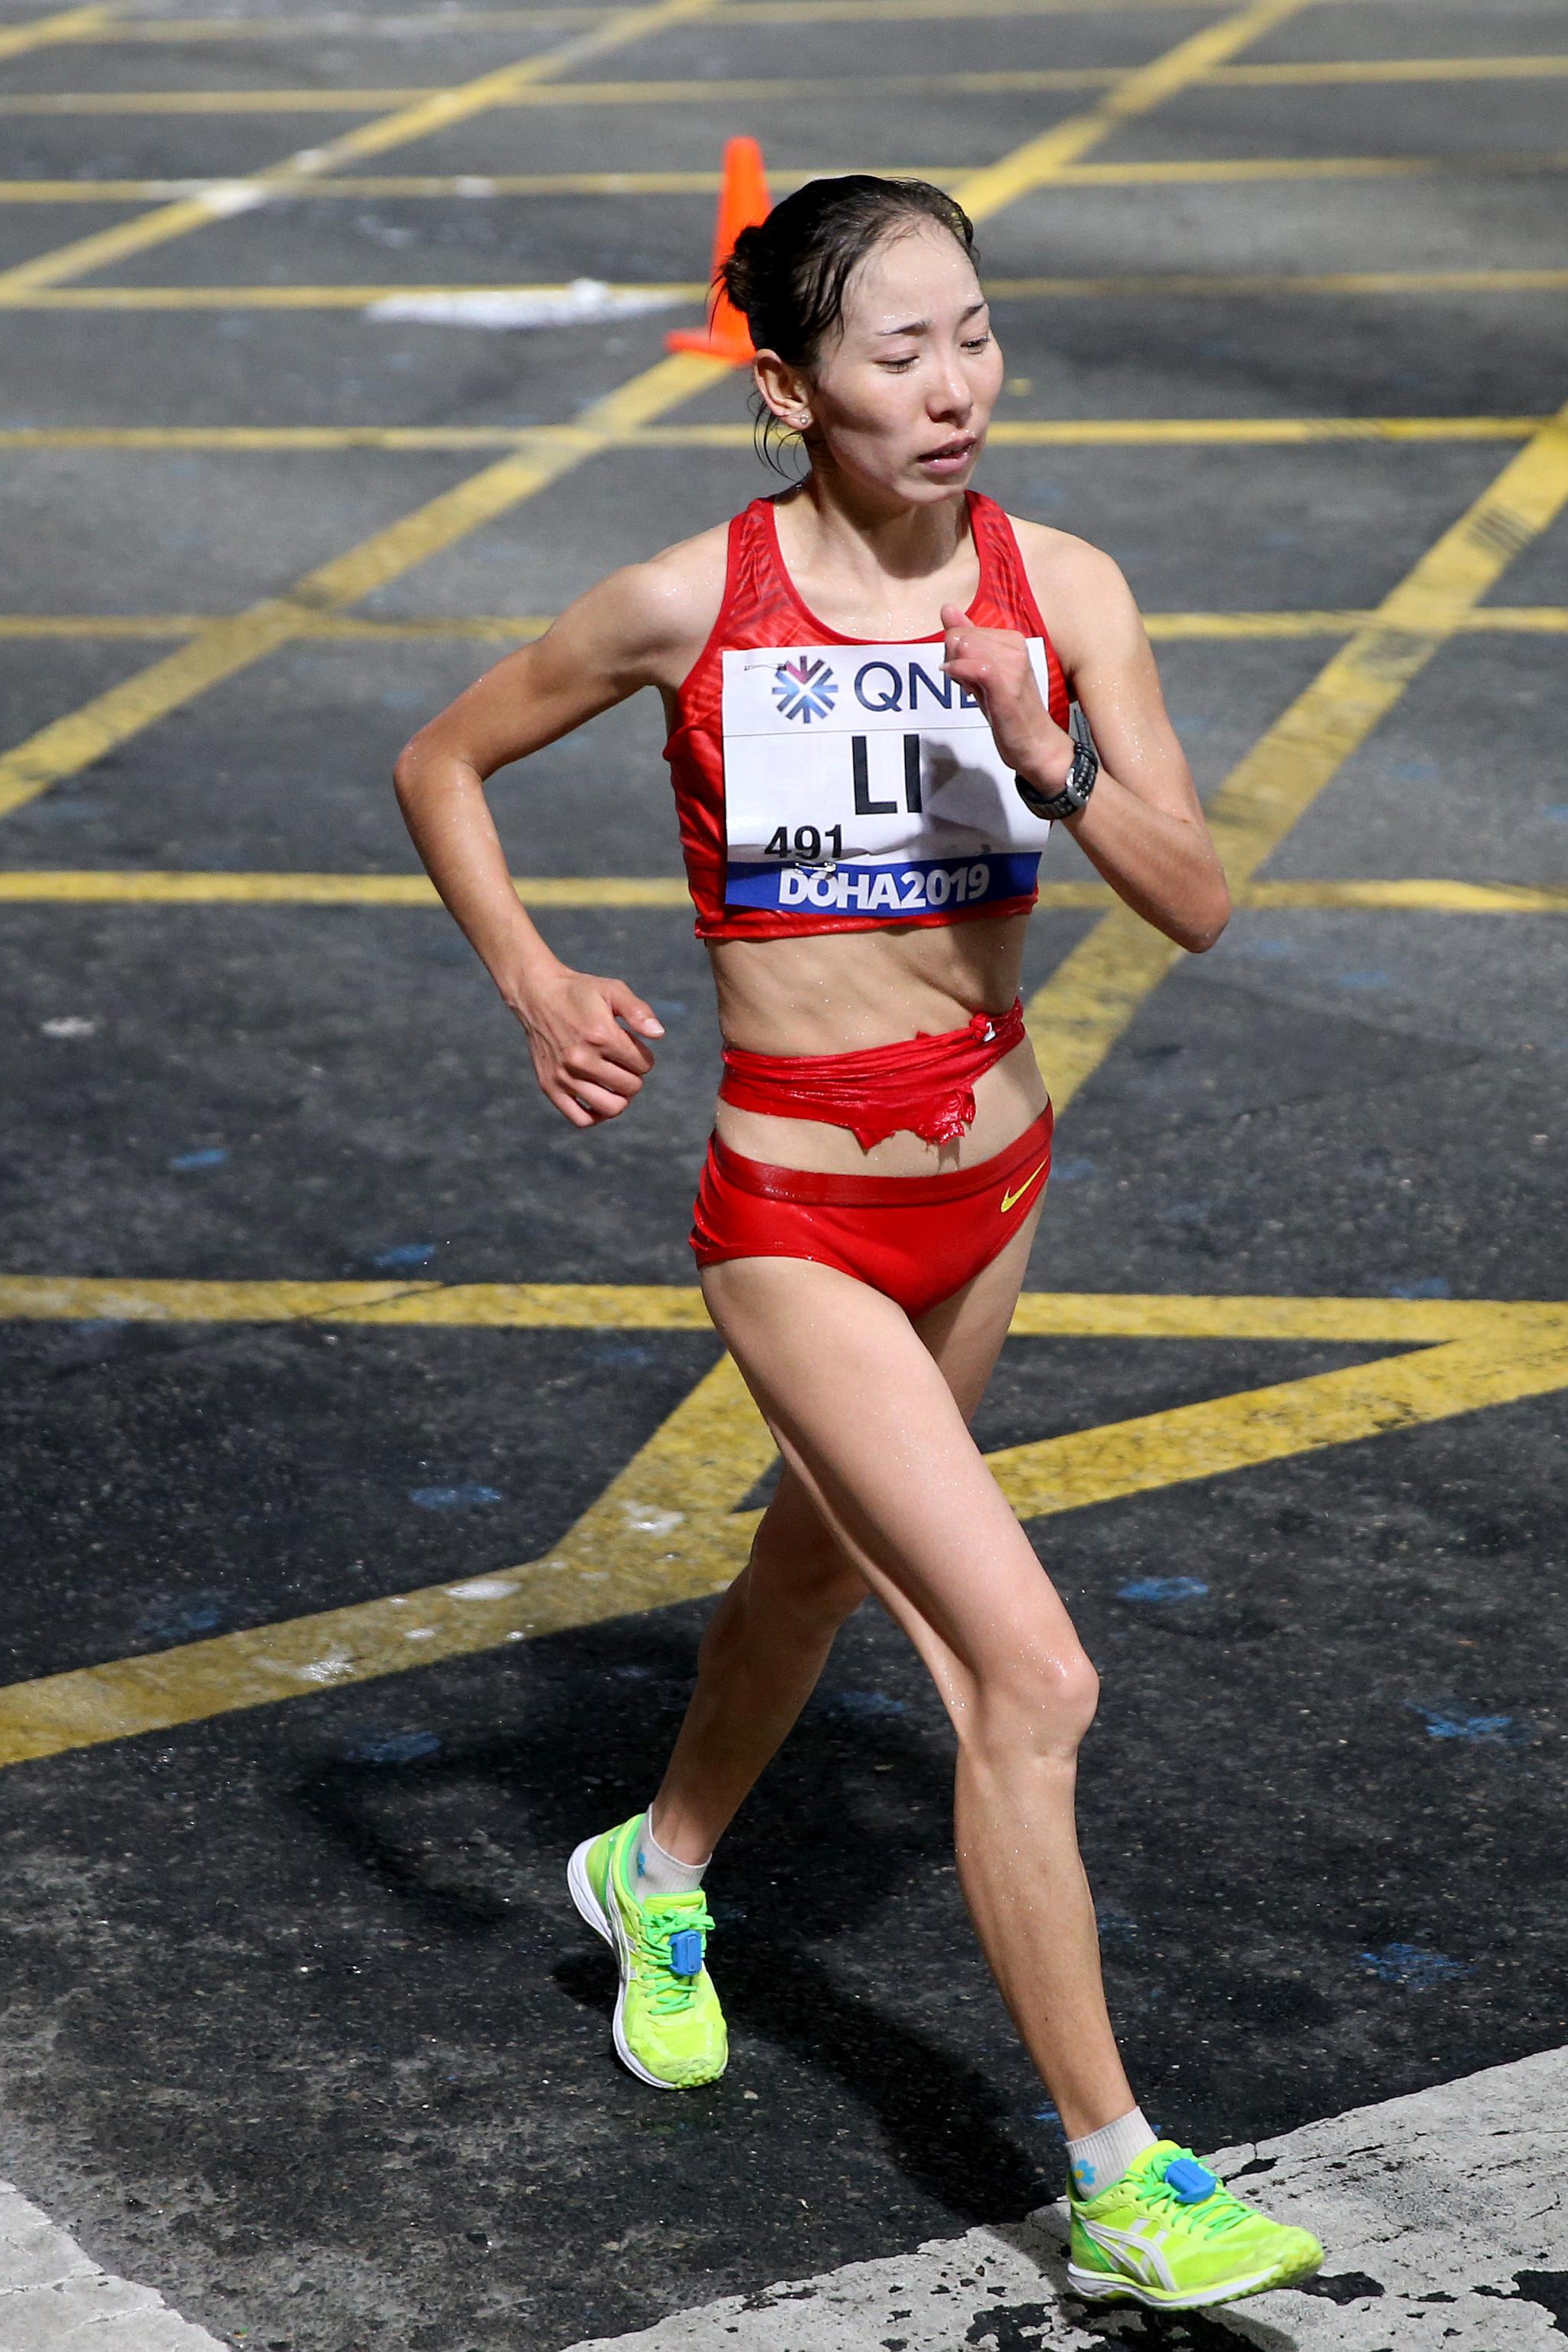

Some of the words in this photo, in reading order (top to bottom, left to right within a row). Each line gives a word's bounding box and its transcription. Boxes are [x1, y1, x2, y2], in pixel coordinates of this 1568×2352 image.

[851, 734, 923, 815] LI
[764, 824, 843, 859] 491
[779, 864, 990, 910] DOHA2019
